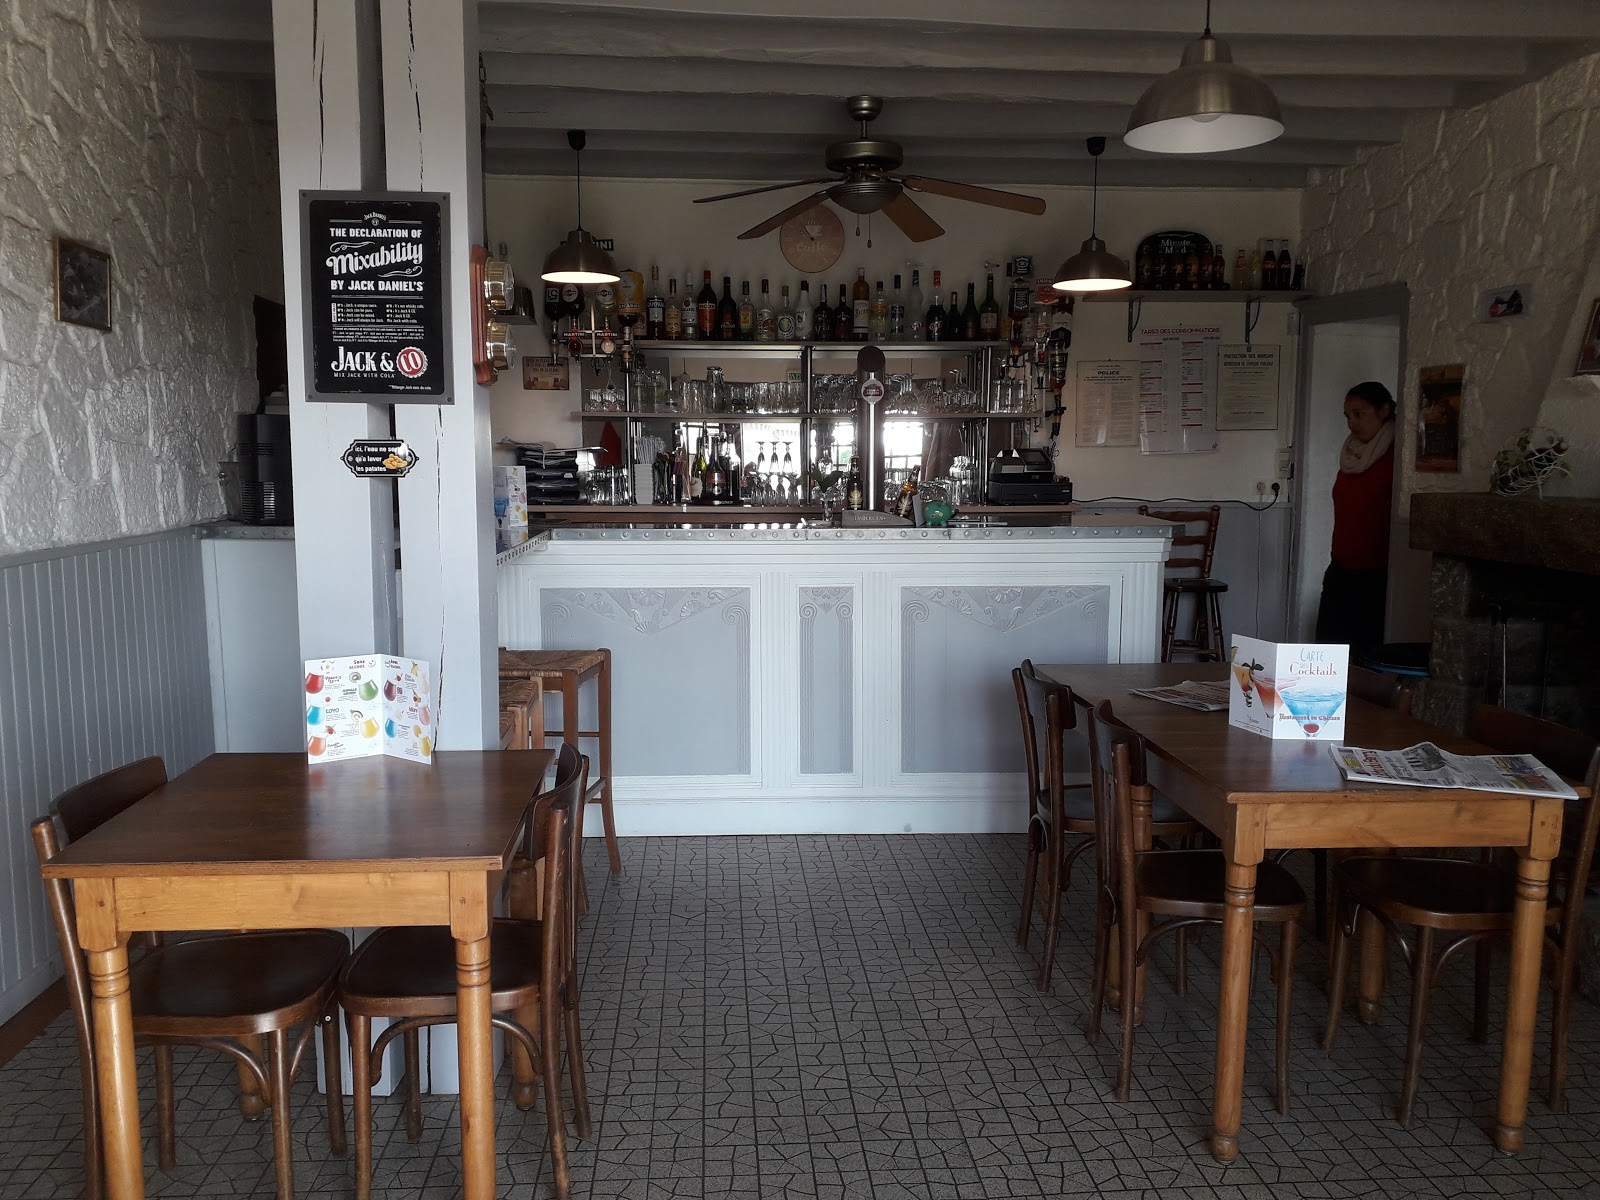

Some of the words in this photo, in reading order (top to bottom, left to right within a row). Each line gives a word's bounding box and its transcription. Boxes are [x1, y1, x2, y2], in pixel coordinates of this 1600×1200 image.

[330, 228, 347, 237] THE
[350, 228, 409, 238] DECLARATION
[410, 229, 422, 238] OF
[325, 241, 423, 275] Mixability
[330, 280, 344, 290] BY
[347, 280, 375, 291] JACK
[378, 281, 424, 292] DANIEL'S
[330, 346, 377, 372] JACK
[380, 351, 395, 372] &
[400, 351, 422, 372] CO
[1300, 648, 1325, 662] CARTE
[1290, 662, 1337, 676] Cocktails
